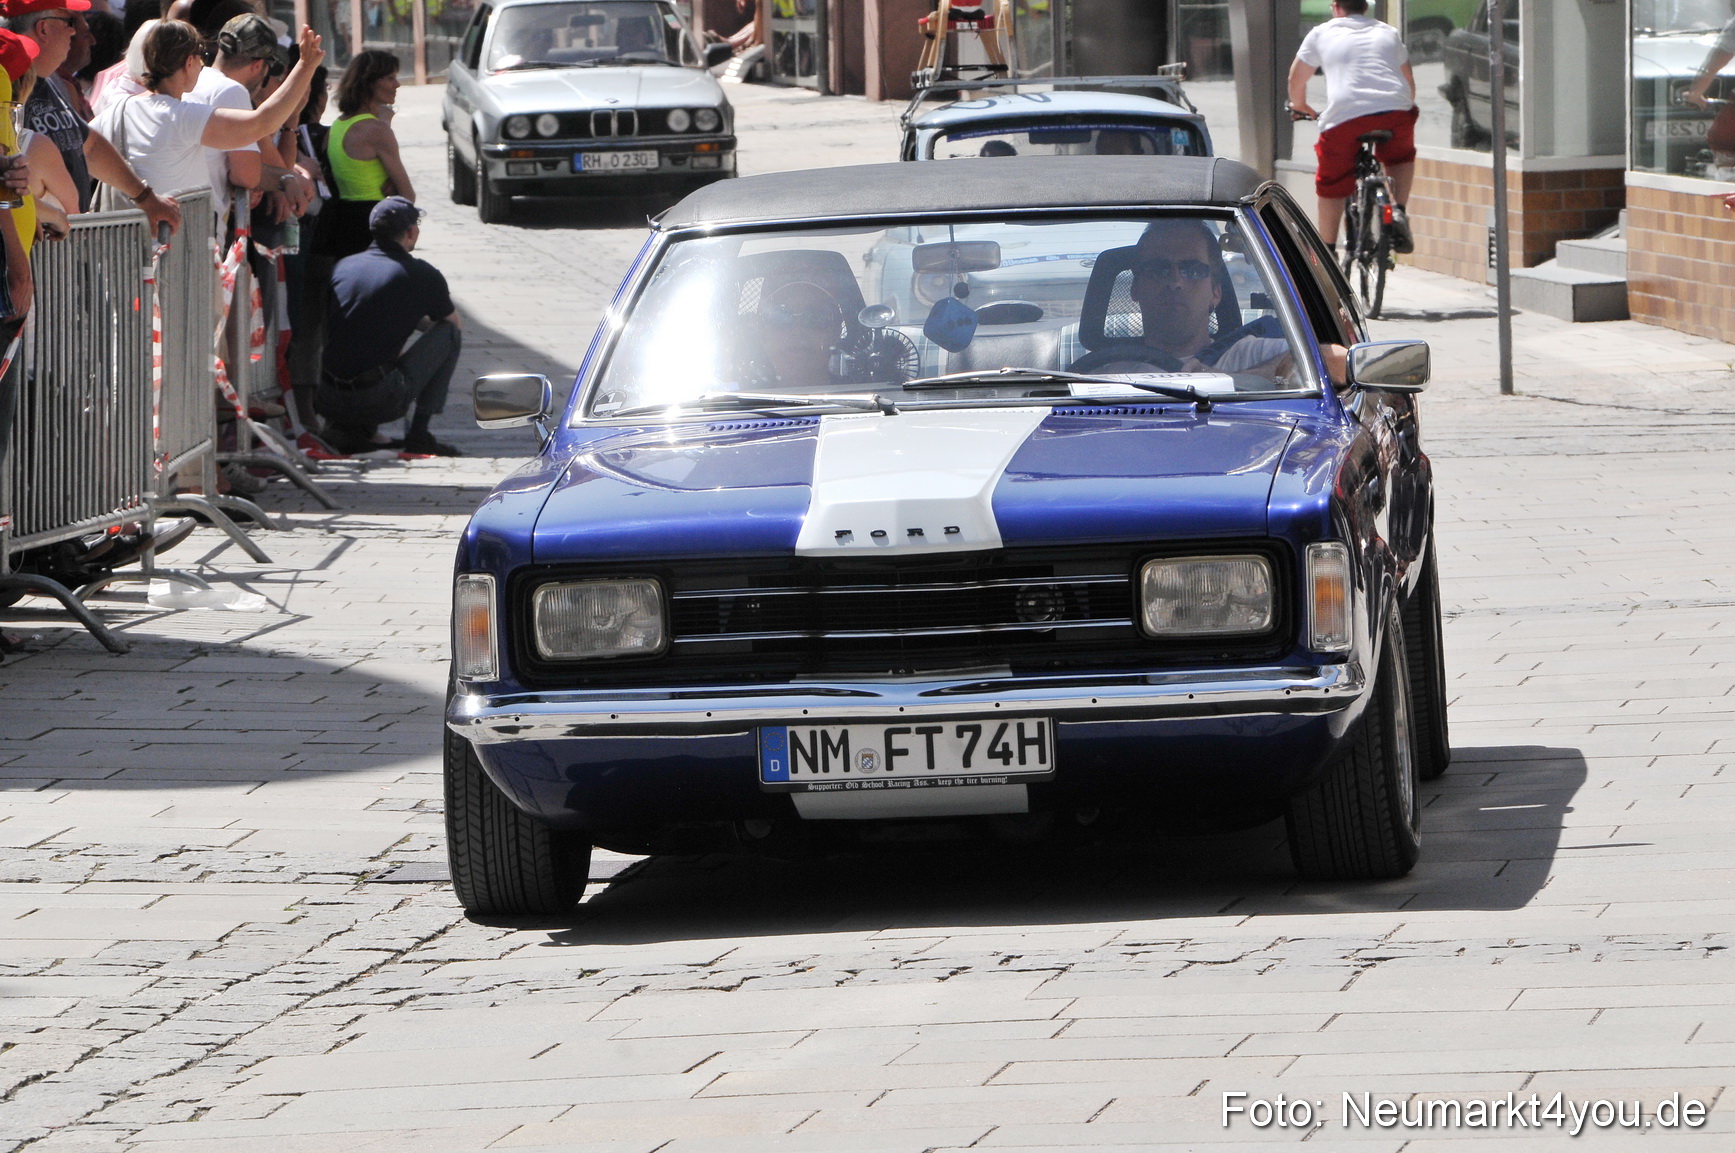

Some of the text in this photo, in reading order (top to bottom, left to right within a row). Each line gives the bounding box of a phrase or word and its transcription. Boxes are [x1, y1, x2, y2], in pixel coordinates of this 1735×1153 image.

[583, 154, 601, 168] RH
[623, 152, 648, 167] 230
[834, 525, 960, 539] FORD
[770, 721, 1047, 775] D NM FT 74H
[808, 782, 843, 791] Supporter:
[846, 781, 859, 790] Old
[862, 780, 885, 789] School
[887, 779, 911, 788] Racing
[913, 779, 929, 788] Ass.
[938, 778, 952, 786] keep
[954, 777, 964, 785] the
[980, 775, 1008, 785] burning!
